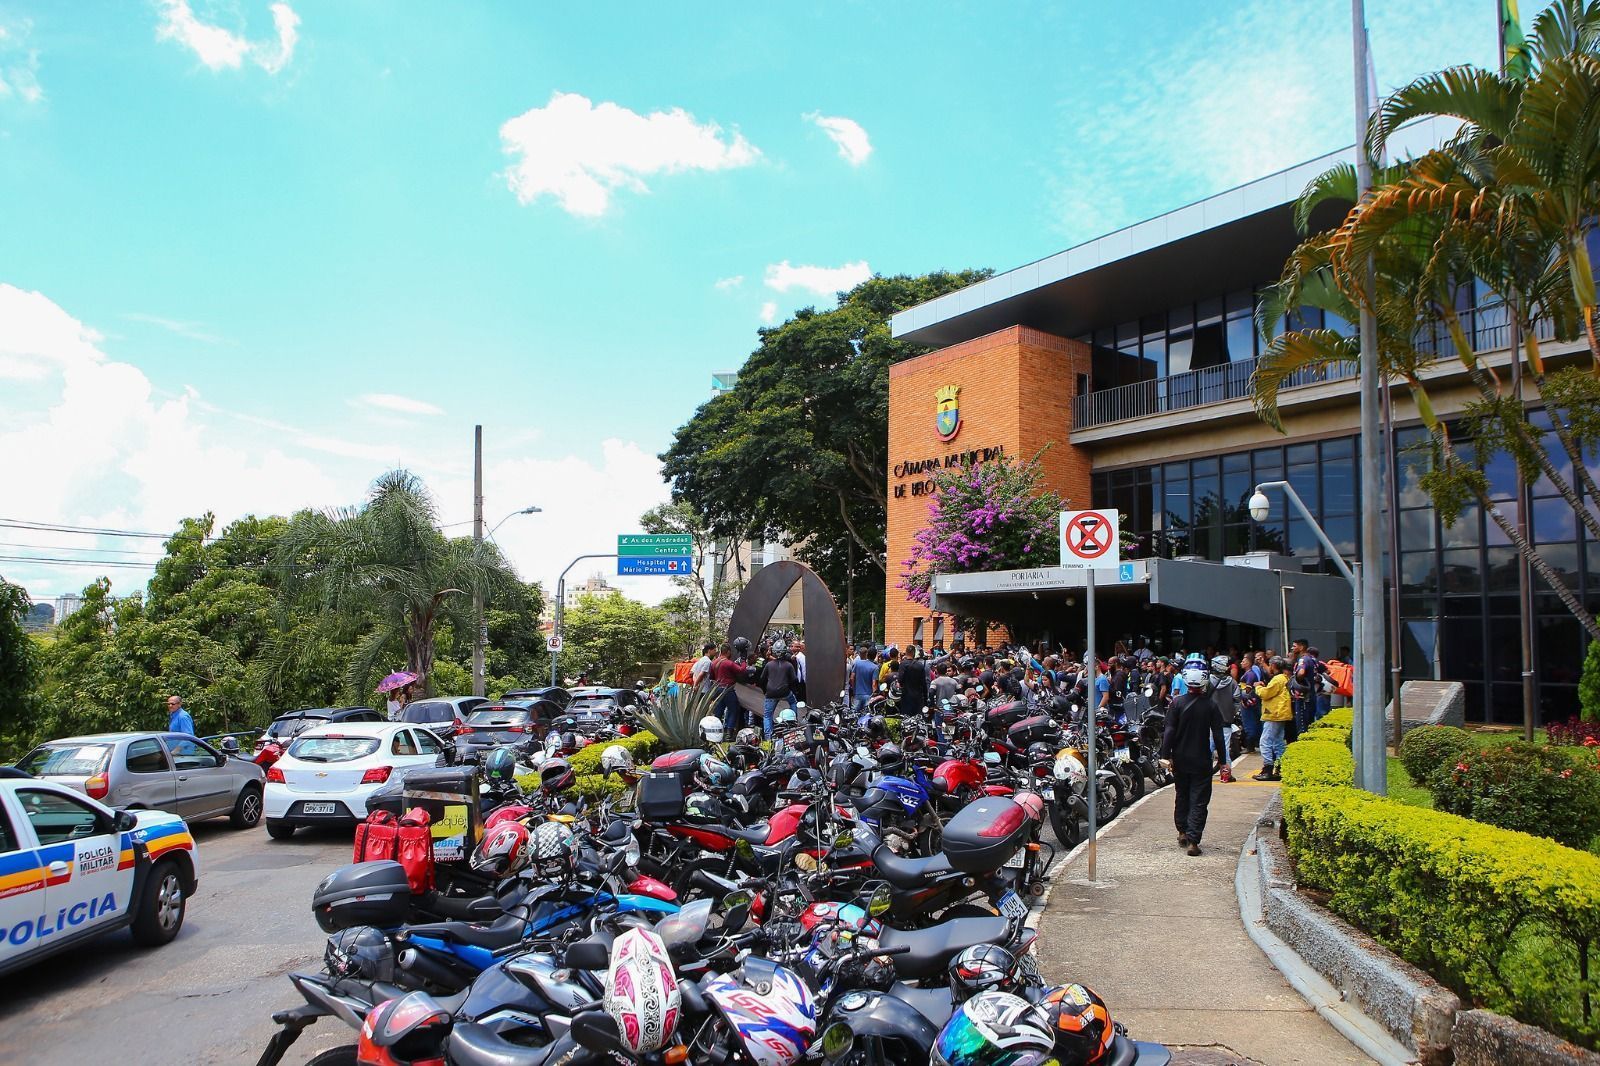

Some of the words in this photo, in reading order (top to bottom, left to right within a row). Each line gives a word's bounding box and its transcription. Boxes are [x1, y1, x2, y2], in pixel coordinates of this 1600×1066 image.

[895, 484, 906, 498] DE
[912, 480, 936, 496] BELO
[637, 559, 665, 567] Hospital
[1011, 571, 1044, 580] PORTARIA
[80, 856, 114, 871] MILITAR
[924, 870, 947, 878] HONDA
